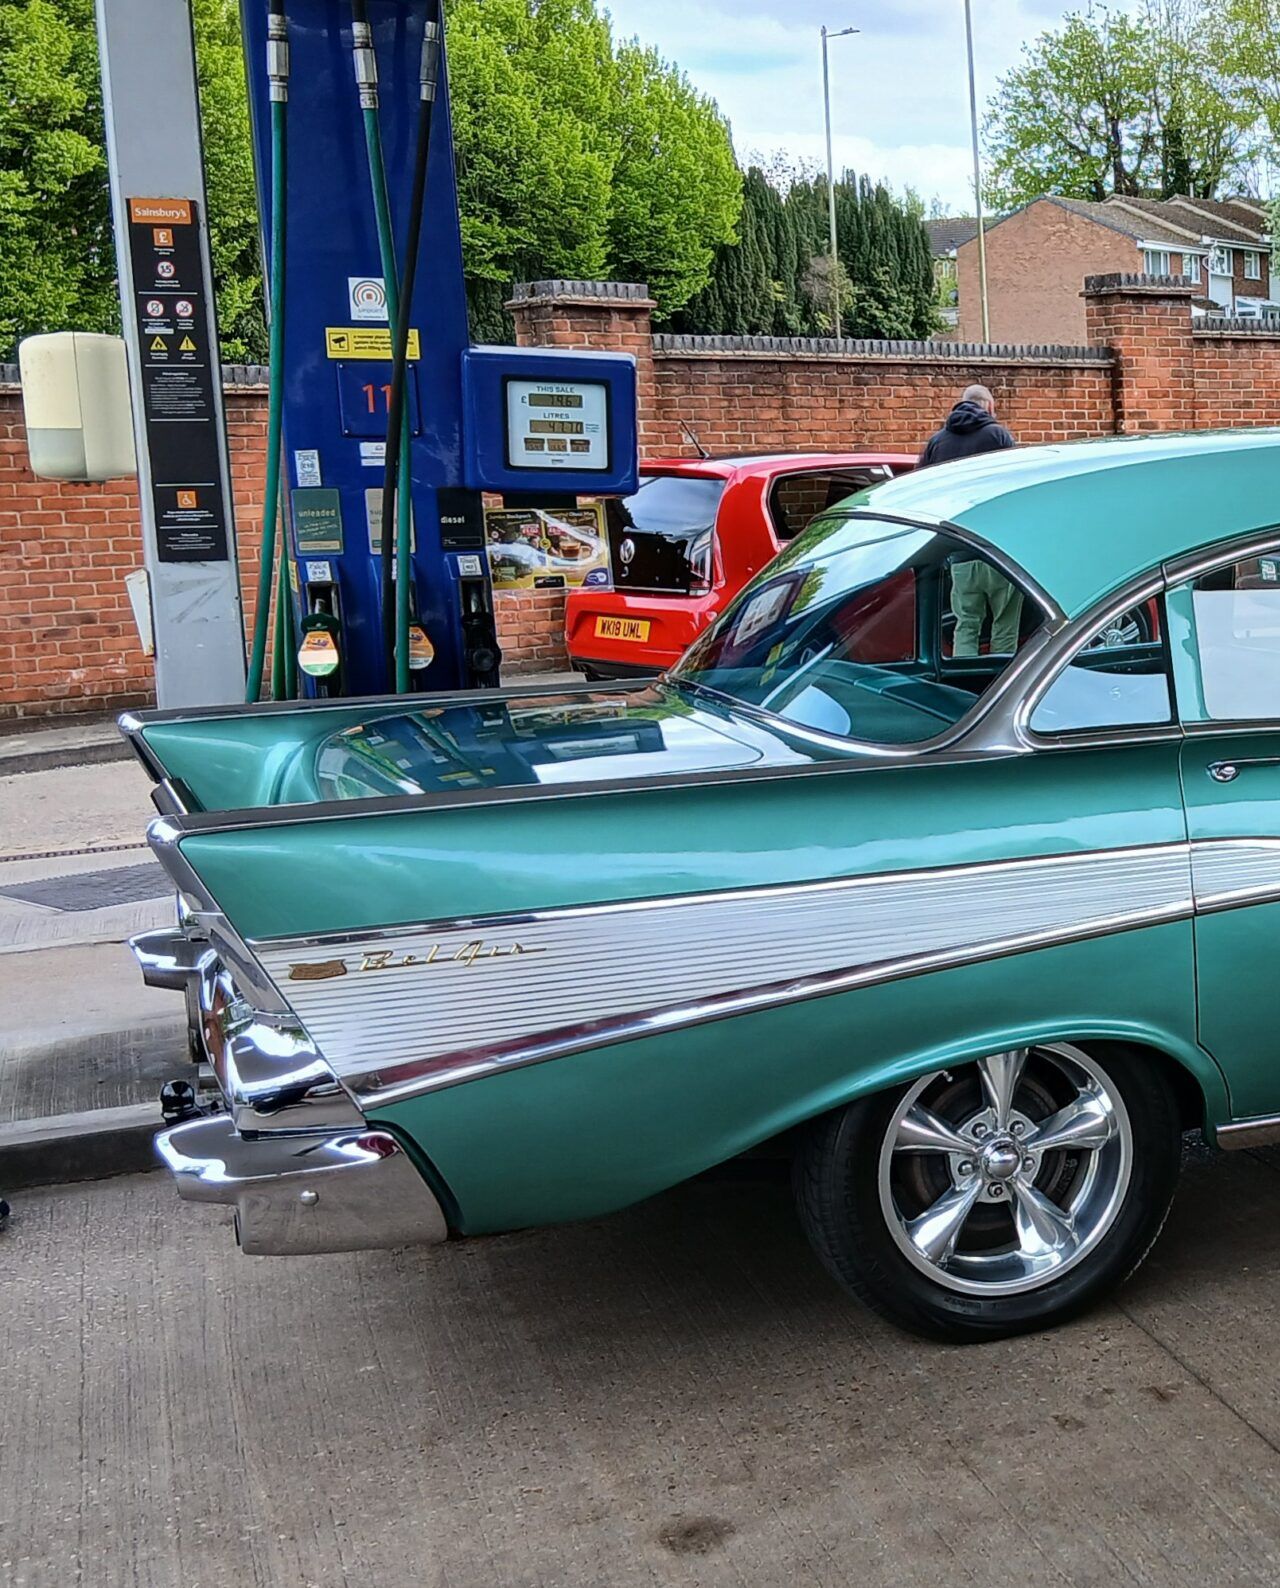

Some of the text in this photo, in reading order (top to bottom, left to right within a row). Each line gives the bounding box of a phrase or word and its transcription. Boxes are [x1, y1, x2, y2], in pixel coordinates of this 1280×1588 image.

[134, 207, 187, 219] Sainsbury's
[362, 384, 392, 413] 11
[521, 395, 527, 404] £
[298, 508, 336, 517] unleaded
[440, 515, 465, 524] diesel
[600, 619, 642, 639] WK18 UML
[359, 939, 524, 971] Bel Air
